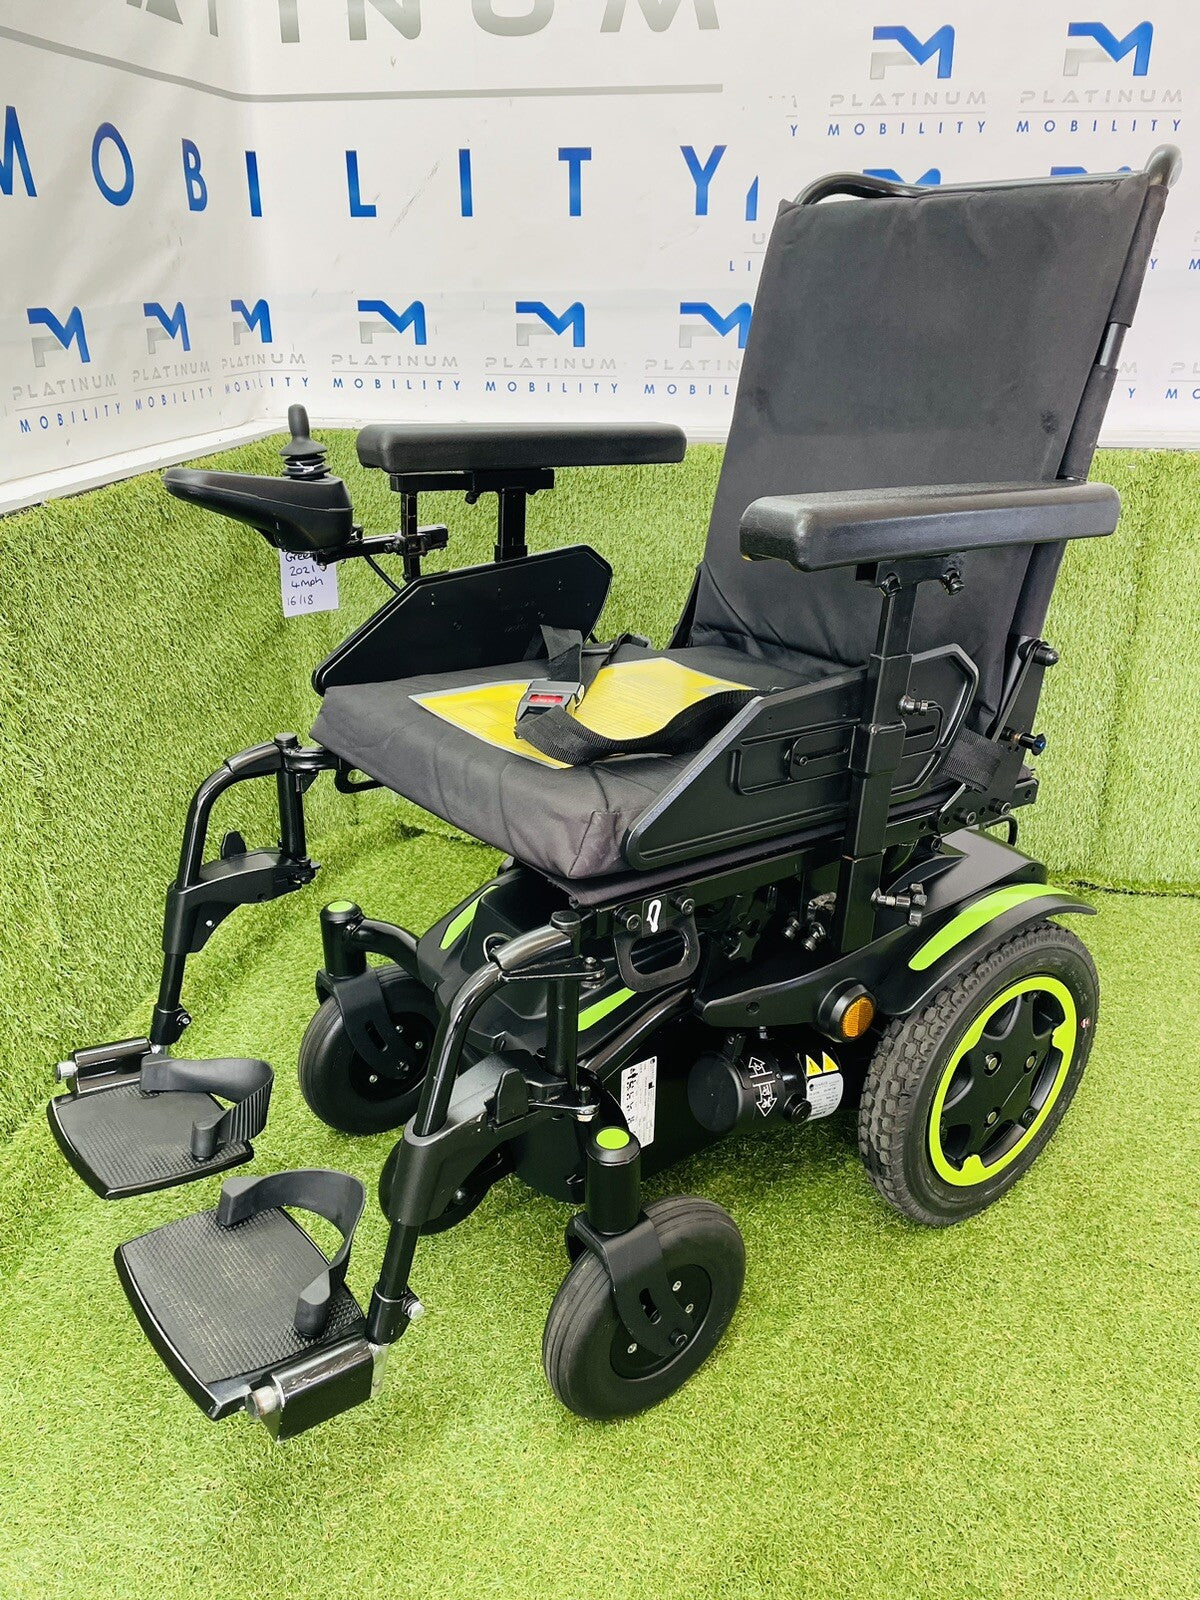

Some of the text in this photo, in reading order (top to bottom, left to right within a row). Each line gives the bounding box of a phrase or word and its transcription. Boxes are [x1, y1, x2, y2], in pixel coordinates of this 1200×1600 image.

[829, 91, 987, 107] PLATINUM
[1020, 89, 1183, 103] PLATINUM
[828, 121, 986, 136] MOBILITY
[1016, 119, 1182, 133] MOBILITY
[221, 353, 306, 370] PLATINUM
[331, 354, 459, 367] PLATINUM
[485, 357, 617, 369] PLATINUM
[644, 359, 740, 371] PLATIN
[132, 361, 211, 383] PLATINUM
[12, 374, 117, 401] PLATINUM
[224, 377, 309, 395] MOBILITY
[333, 378, 460, 391] MOBILITY
[485, 381, 618, 394] MOBILITY
[644, 384, 730, 395] MOBIL
[135, 386, 214, 411] MOBILITY
[20, 402, 121, 433] MOBILITY
[289, 565, 316, 577] 2021
